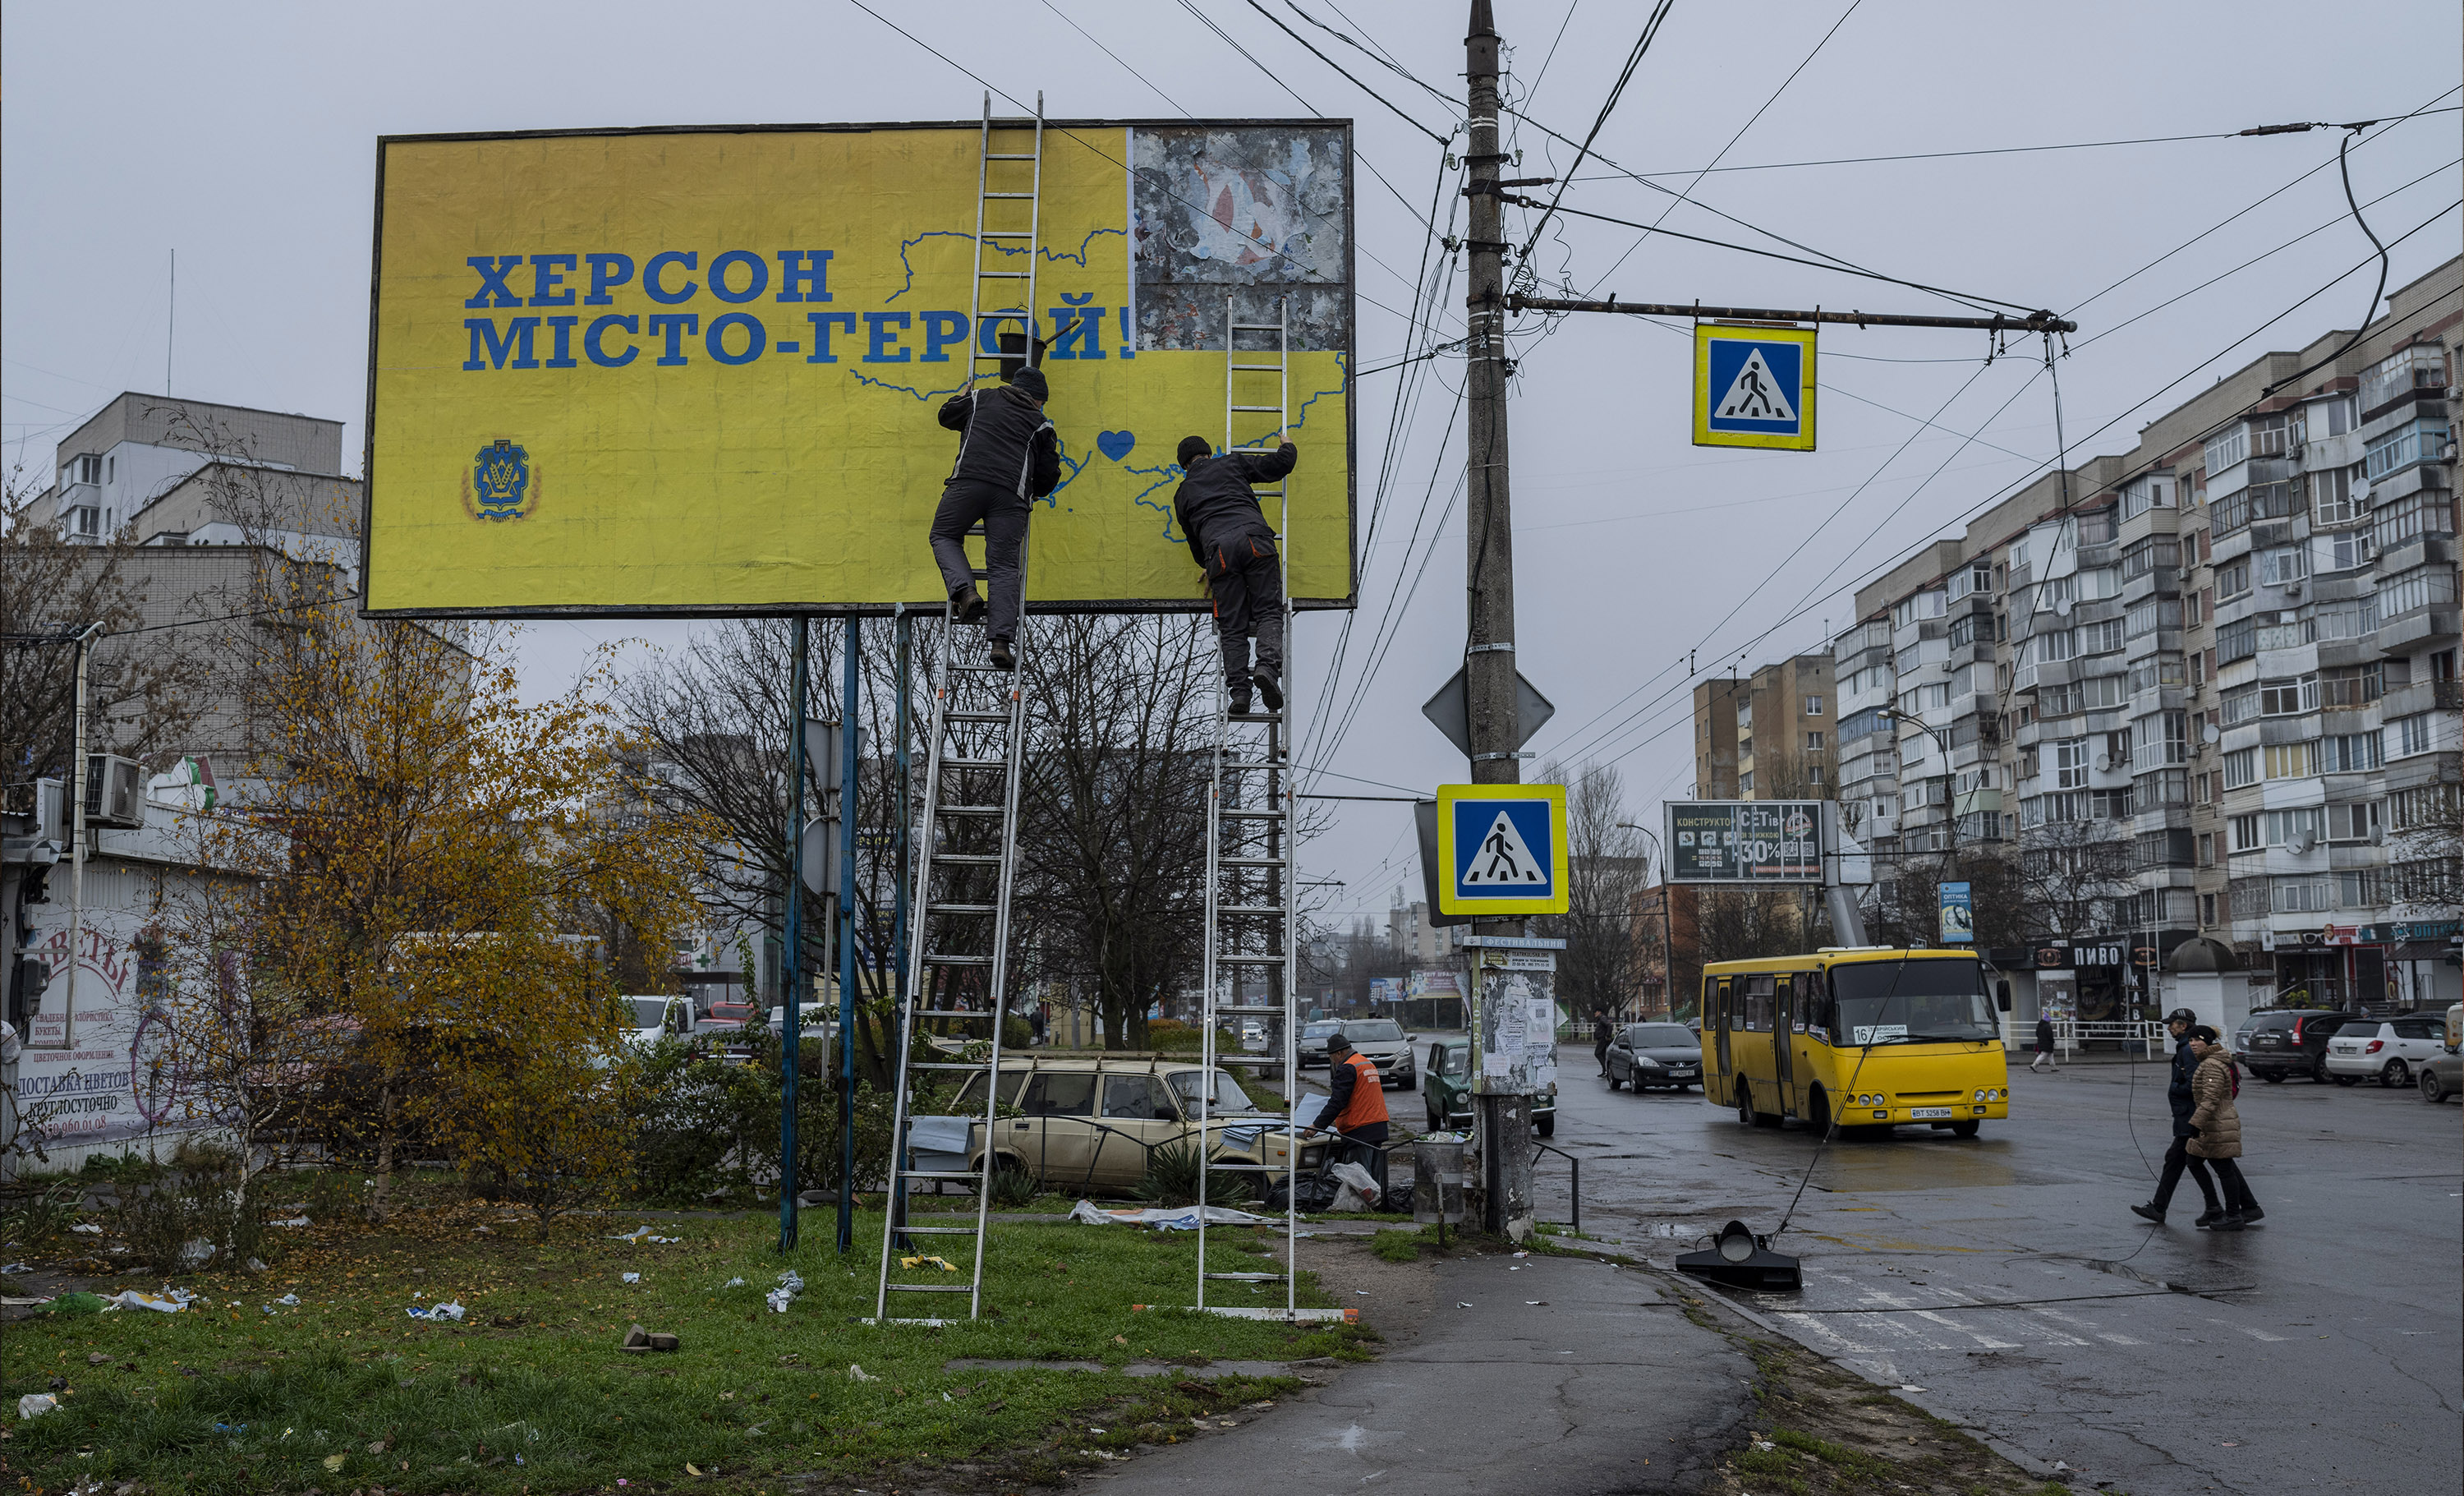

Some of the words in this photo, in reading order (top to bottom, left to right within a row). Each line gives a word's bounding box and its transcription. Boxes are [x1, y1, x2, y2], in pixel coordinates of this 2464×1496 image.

[464, 250, 834, 309] ХЕРСОН
[1486, 938, 1563, 948] ФЕСТИВАЛЬНИЙ
[2074, 947, 2119, 966] ПИВО
[1473, 987, 1482, 1049] 49-10-22
[34, 1026, 62, 1036] БУКЕТЫ,
[1855, 1029, 1868, 1042] 16
[34, 1052, 72, 1063] ЦВЕТОЧНОЕ
[18, 1075, 81, 1099] ДОСТАВКА
[84, 1071, 129, 1093] ЦВЕТОВ
[29, 1095, 117, 1118] КРУГЛОСУТОЧНО
[62, 1118, 80, 1138] 960
[82, 1119, 92, 1131] 01
[95, 1115, 106, 1130] 08
